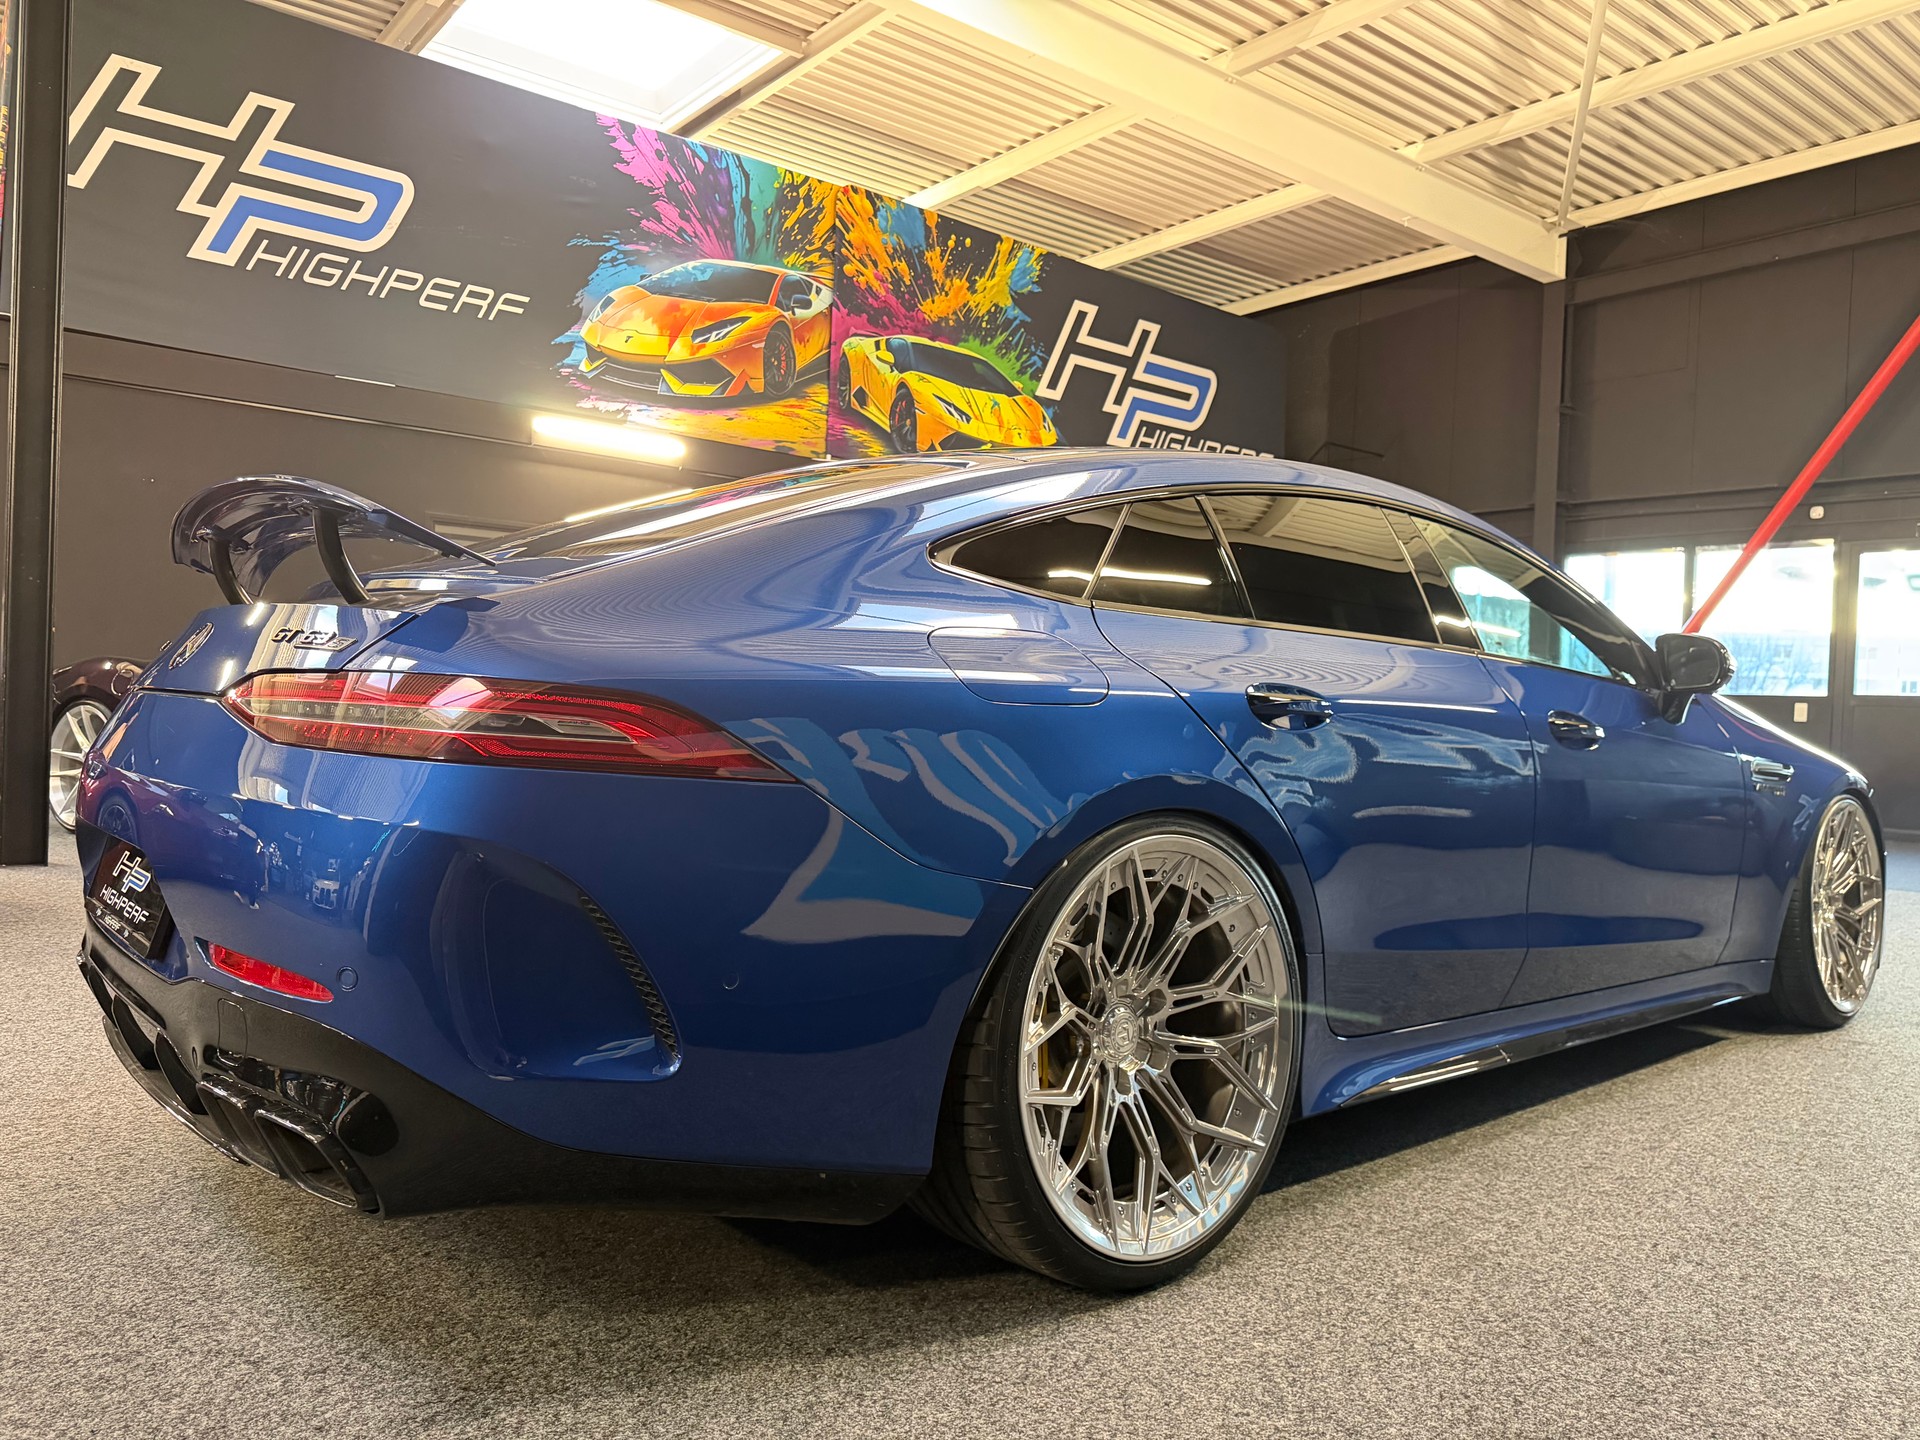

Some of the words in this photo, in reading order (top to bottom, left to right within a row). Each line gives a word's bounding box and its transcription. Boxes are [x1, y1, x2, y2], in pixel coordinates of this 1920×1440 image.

[67, 53, 415, 266] HP
[246, 238, 530, 321] HIGHPERF
[1035, 299, 1218, 447] HP
[271, 626, 305, 644] GT
[300, 630, 338, 645] 63
[112, 851, 152, 893] HP
[99, 884, 150, 925] HIGHPERF
